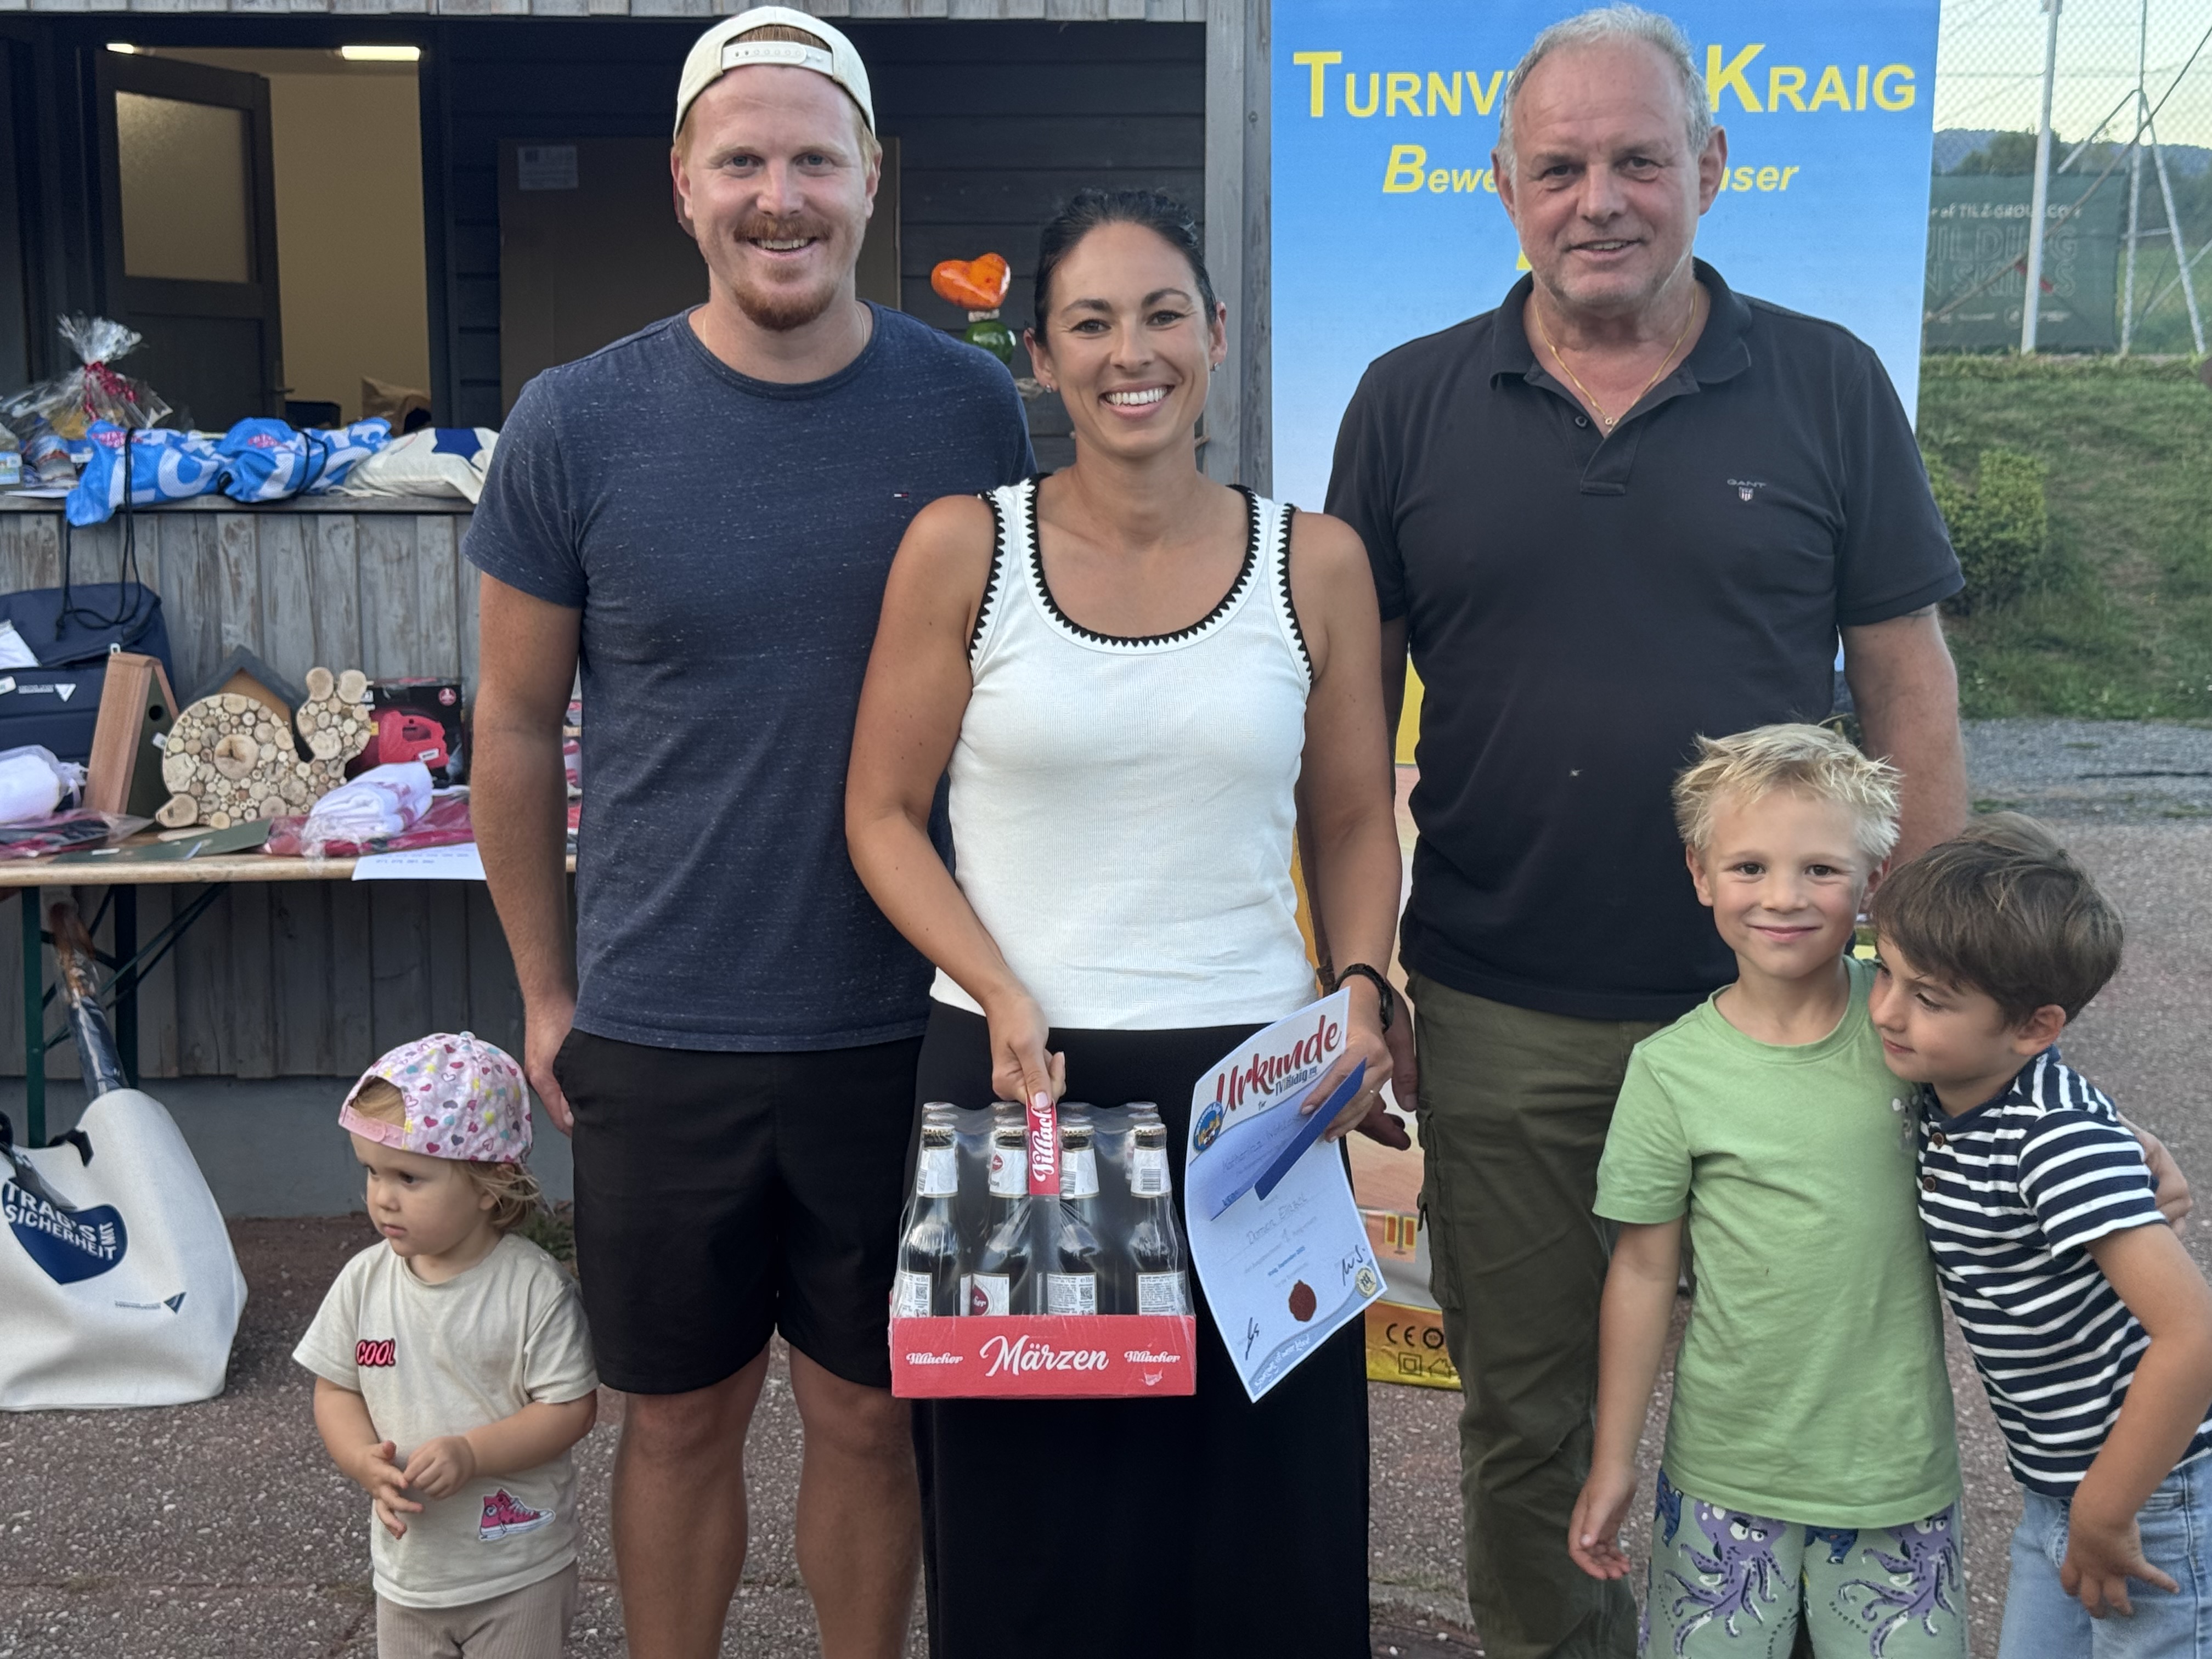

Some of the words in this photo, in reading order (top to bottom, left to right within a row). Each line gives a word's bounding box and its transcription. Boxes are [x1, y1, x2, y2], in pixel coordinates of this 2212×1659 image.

[1293, 50, 1517, 117] TURNV
[1706, 43, 1916, 112] KRAIG
[1383, 144, 1499, 193] Bewe
[1727, 478, 1767, 488] GANT
[1216, 1014, 1342, 1111] Urkunde
[1030, 1105, 1055, 1182] Villach
[5, 1204, 117, 1260] SICHERHEIT
[6, 1180, 97, 1242] TRAG'S
[356, 1339, 396, 1367] COOL
[906, 1352, 963, 1365] Villacher
[979, 1334, 1109, 1377] Märzen
[1124, 1350, 1182, 1364] Villacher
